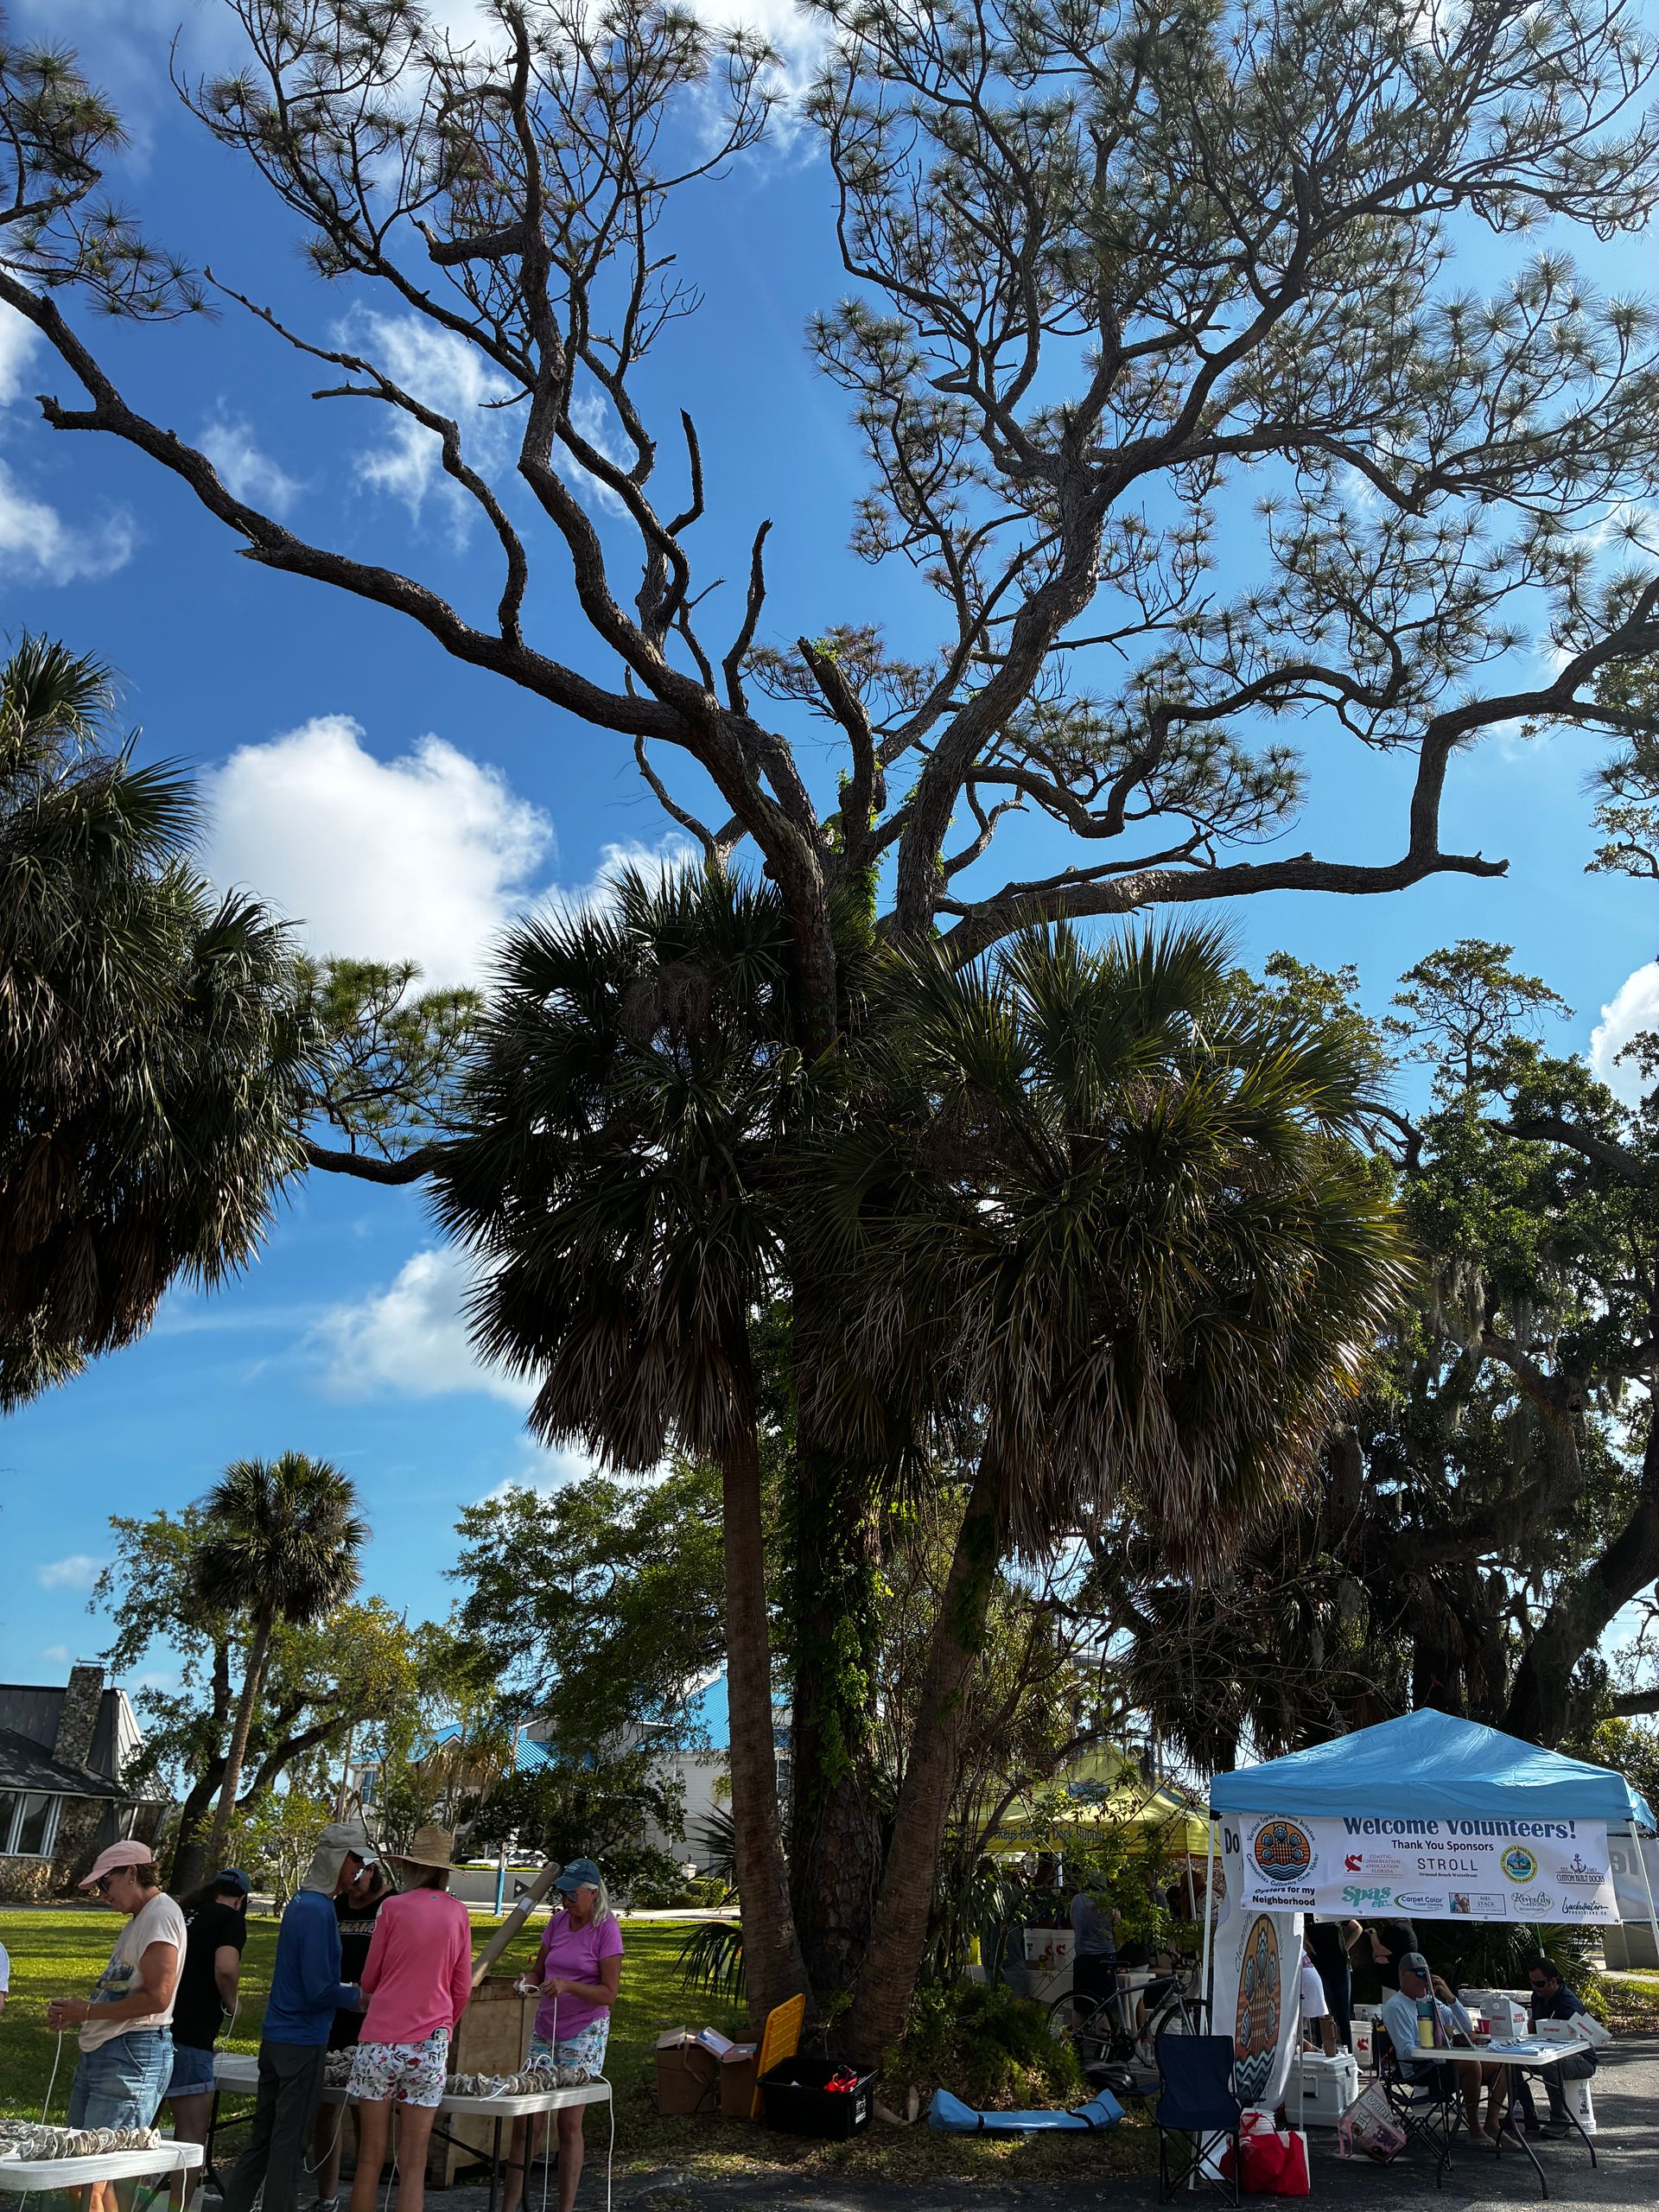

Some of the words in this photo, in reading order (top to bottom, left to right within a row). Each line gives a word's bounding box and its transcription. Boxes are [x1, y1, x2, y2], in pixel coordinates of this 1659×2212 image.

[1343, 1817, 1439, 1835] Welcome
[1446, 1820, 1577, 1840] Volunteers!
[1391, 1840, 1423, 1850] Thank
[1425, 1840, 1444, 1851] You
[1446, 1841, 1494, 1853] Sponsors
[1297, 1872, 1312, 1883] Clean
[1309, 1853, 1319, 1872] Water
[1417, 1858, 1478, 1872] STROLL
[1255, 1886, 1286, 1895] Oysters
[1301, 1887, 1315, 1896] my
[1342, 1885, 1391, 1907] Spas
[1252, 1895, 1316, 1906] Neighborhood
